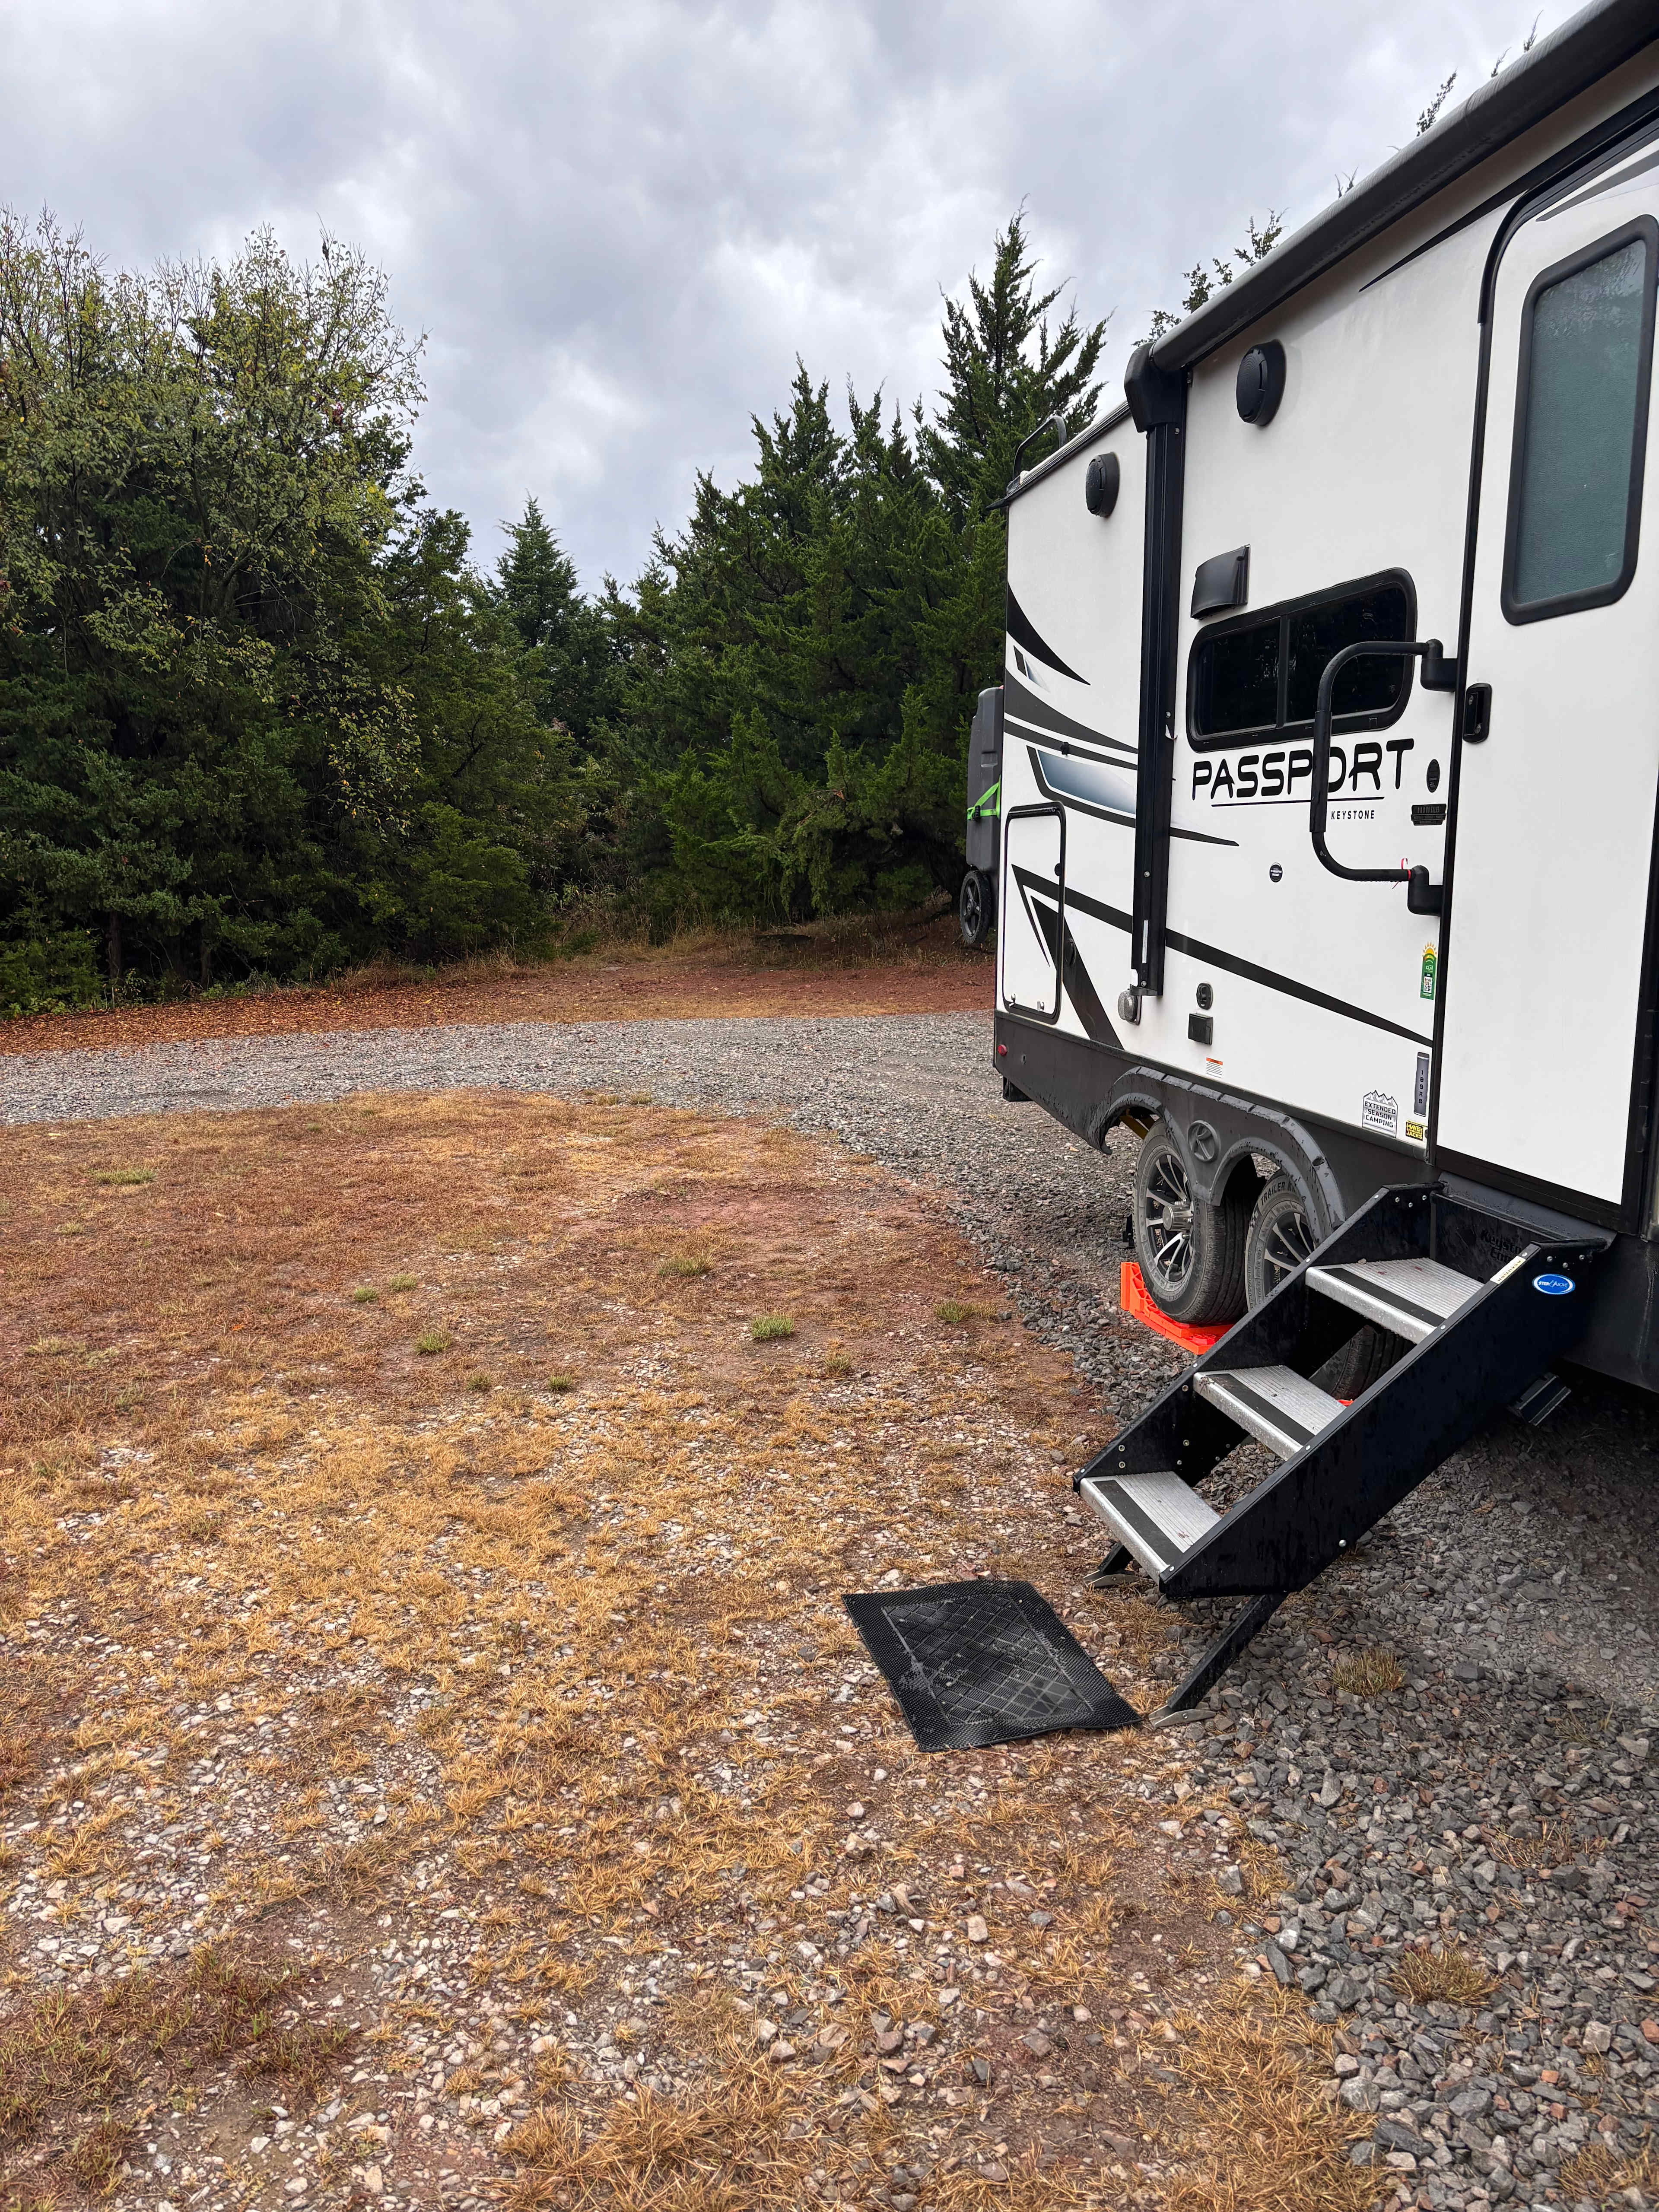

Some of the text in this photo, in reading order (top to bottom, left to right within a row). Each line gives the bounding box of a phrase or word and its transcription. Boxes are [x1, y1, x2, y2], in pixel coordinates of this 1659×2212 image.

[1192, 738, 1414, 801] PASSPORT
[1331, 810, 1375, 820] KEYSTONE
[1364, 1102, 1396, 1115] EXTENDED
[1368, 1109, 1392, 1120] SEASON
[1366, 1115, 1393, 1128] CAMPING
[1406, 1131, 1423, 1139] JACKS
[1260, 1182, 1285, 1205] TRAILER
